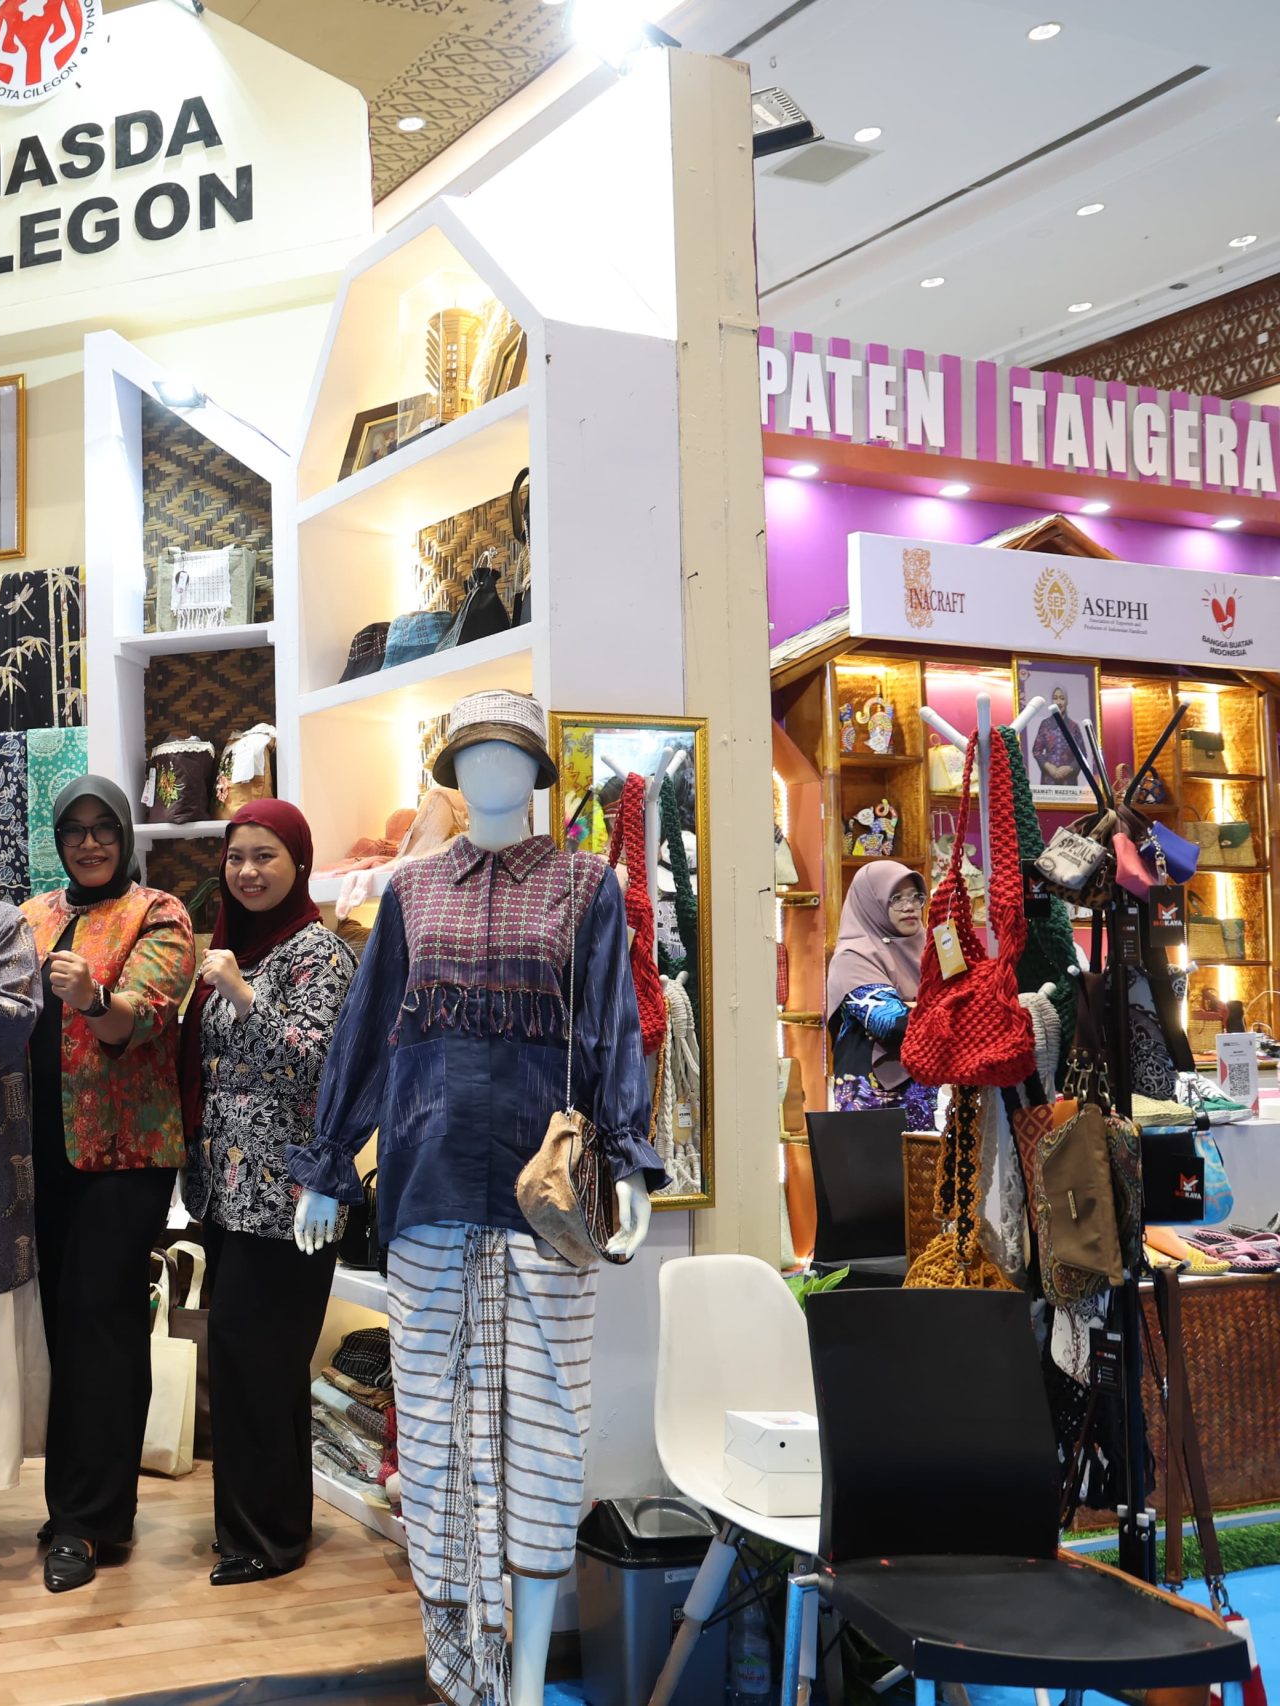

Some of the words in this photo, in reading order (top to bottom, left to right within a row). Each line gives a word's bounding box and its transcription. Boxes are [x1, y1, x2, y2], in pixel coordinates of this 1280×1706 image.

[23, 61, 78, 99] CILEGON
[759, 345, 946, 448] PATEN
[1012, 386, 1277, 493] TANGERA
[909, 588, 966, 614] INACRAFT
[1082, 597, 1149, 620] ASEPHI
[1202, 635, 1228, 648] BANGGA
[1229, 638, 1253, 648] BUATAN
[1209, 647, 1247, 656] INDONESIA
